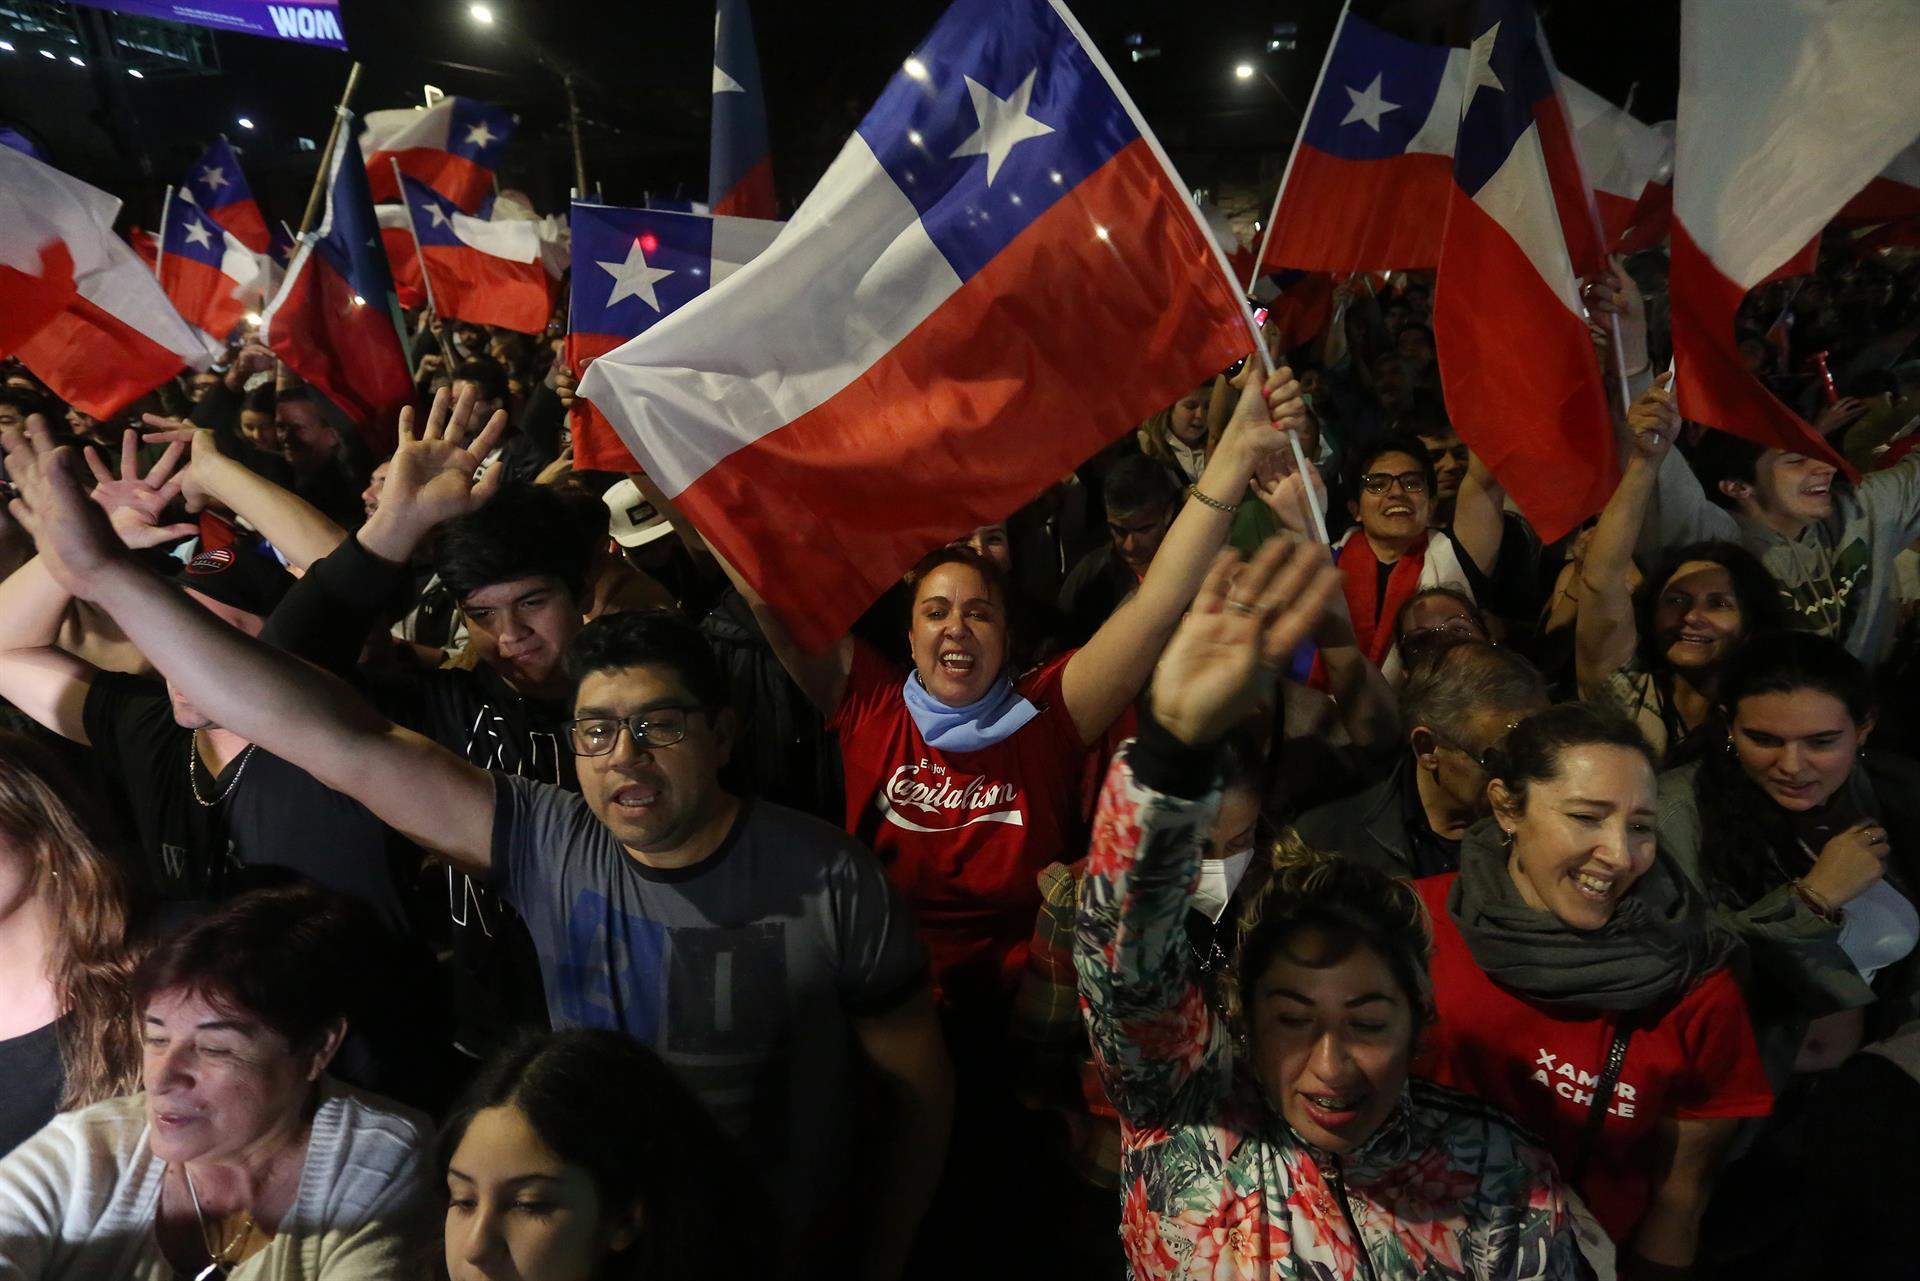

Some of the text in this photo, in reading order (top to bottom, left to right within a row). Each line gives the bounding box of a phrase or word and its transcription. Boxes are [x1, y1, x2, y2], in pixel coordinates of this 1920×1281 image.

[268, 5, 343, 40] WOM
[886, 765, 1018, 813] Capitalism
[920, 758, 946, 776] Enjoy
[1531, 1069, 1635, 1118] A CHE
[1535, 1048, 1637, 1101] X AMR
